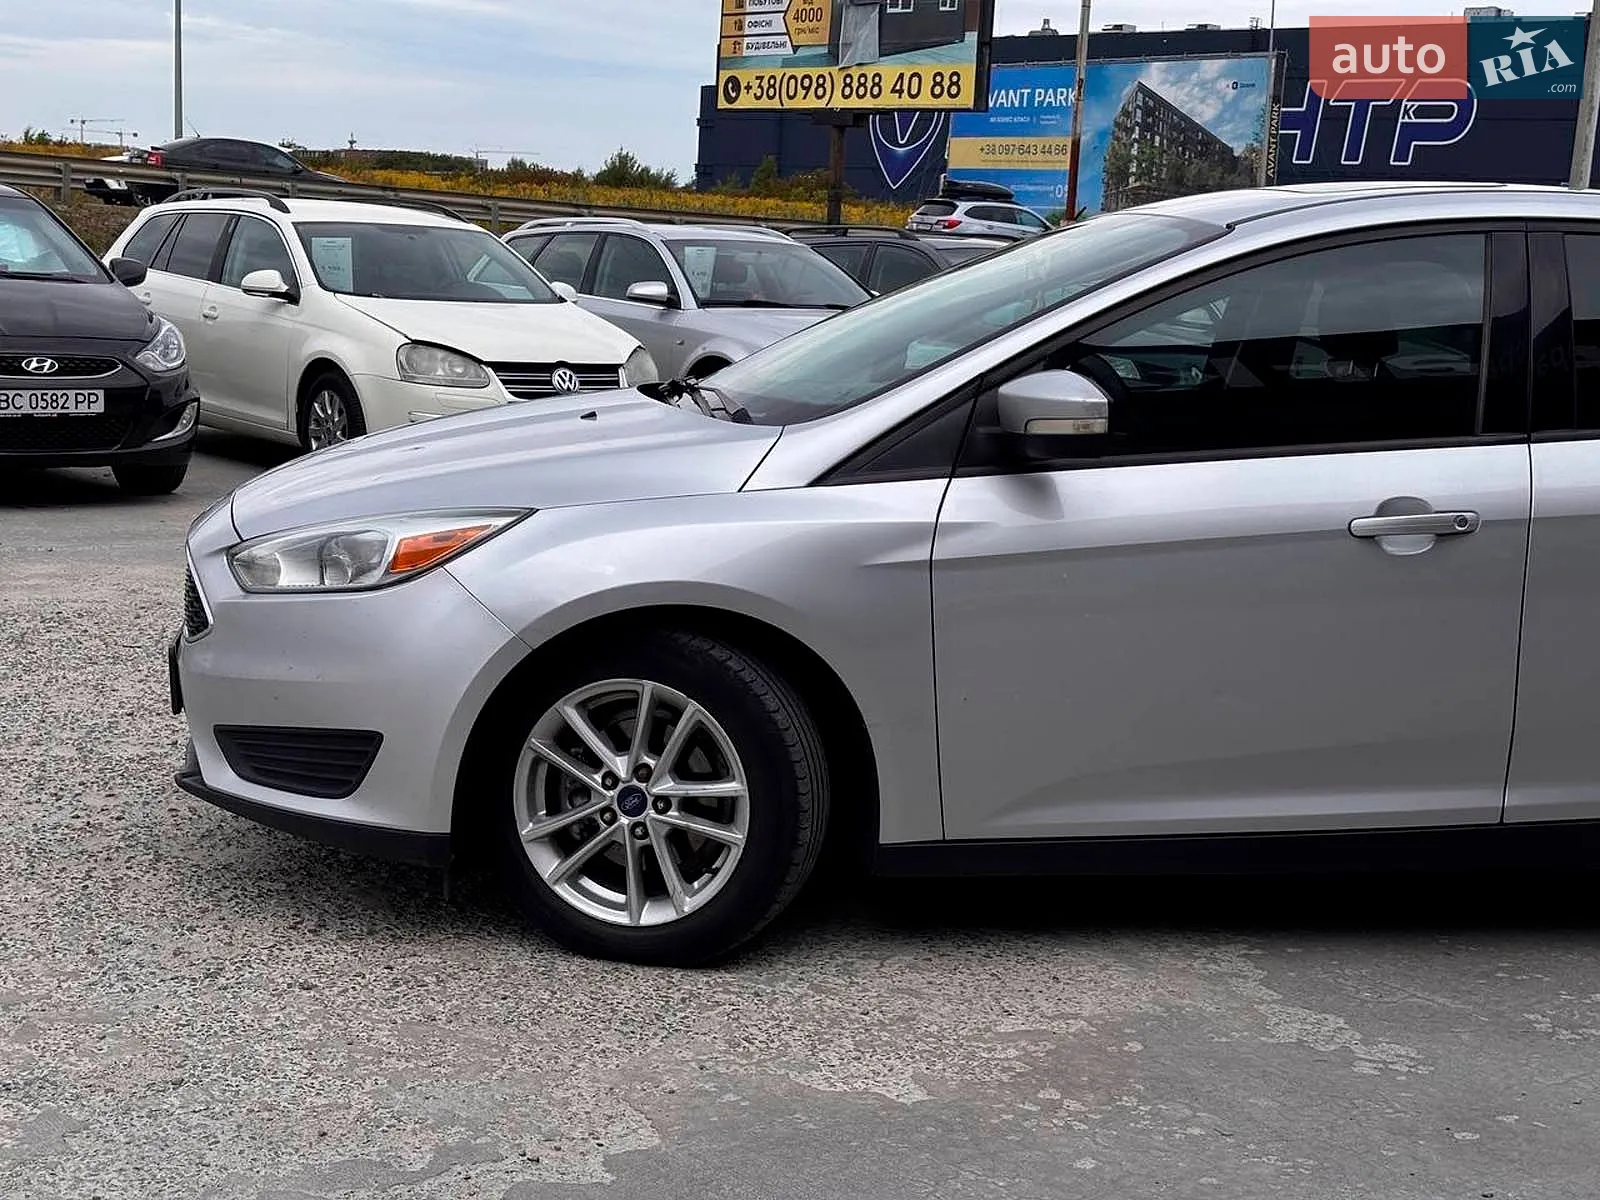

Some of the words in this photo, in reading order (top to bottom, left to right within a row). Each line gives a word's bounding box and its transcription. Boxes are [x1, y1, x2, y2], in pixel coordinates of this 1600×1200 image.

[747, 20, 773, 28] ОФІСНІ
[793, 8, 823, 22] 4000
[746, 41, 788, 50] БУДІВЕЛЬНІ
[743, 71, 835, 107] +38(098)
[841, 72, 882, 100] 888
[890, 72, 922, 99] 40
[930, 71, 961, 99] 88
[1034, 88, 1076, 107] PARK
[1271, 103, 1280, 134] PARK
[1267, 136, 1277, 178] AVANT
[29, 392, 70, 410] 0582
